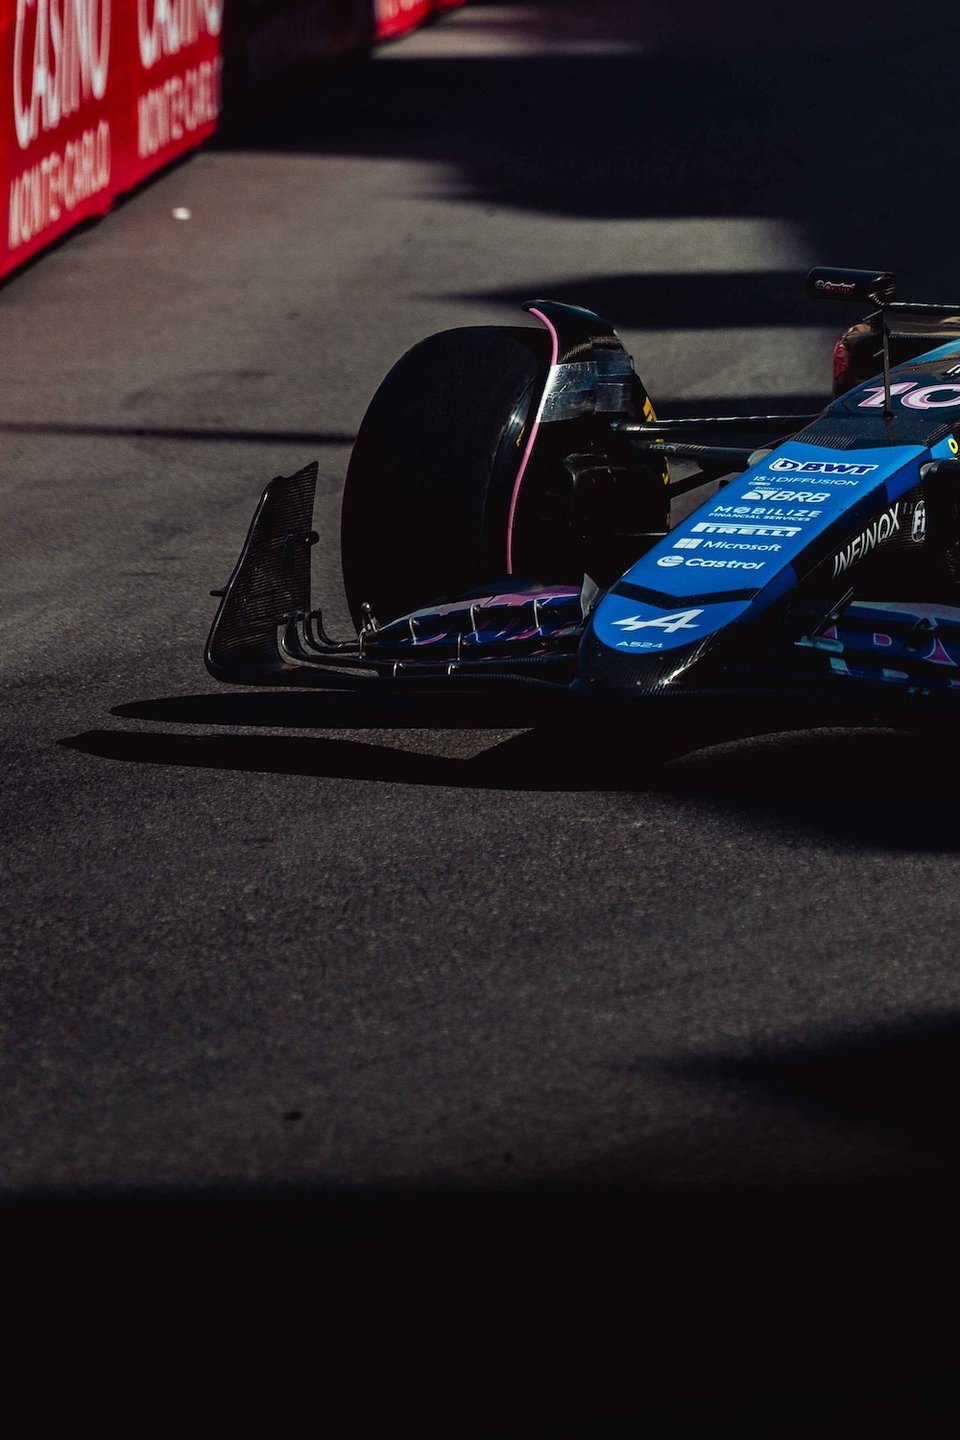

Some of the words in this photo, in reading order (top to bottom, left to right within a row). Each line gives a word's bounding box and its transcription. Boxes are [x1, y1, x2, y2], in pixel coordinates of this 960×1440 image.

[799, 461, 879, 476] BWT
[777, 477, 859, 486] DIFFUSION
[770, 490, 831, 503] BRB
[690, 522, 802, 537] PIRELLI
[702, 540, 782, 552] Microsoft
[831, 502, 900, 580] INFINOX
[685, 558, 766, 570] Castrol
